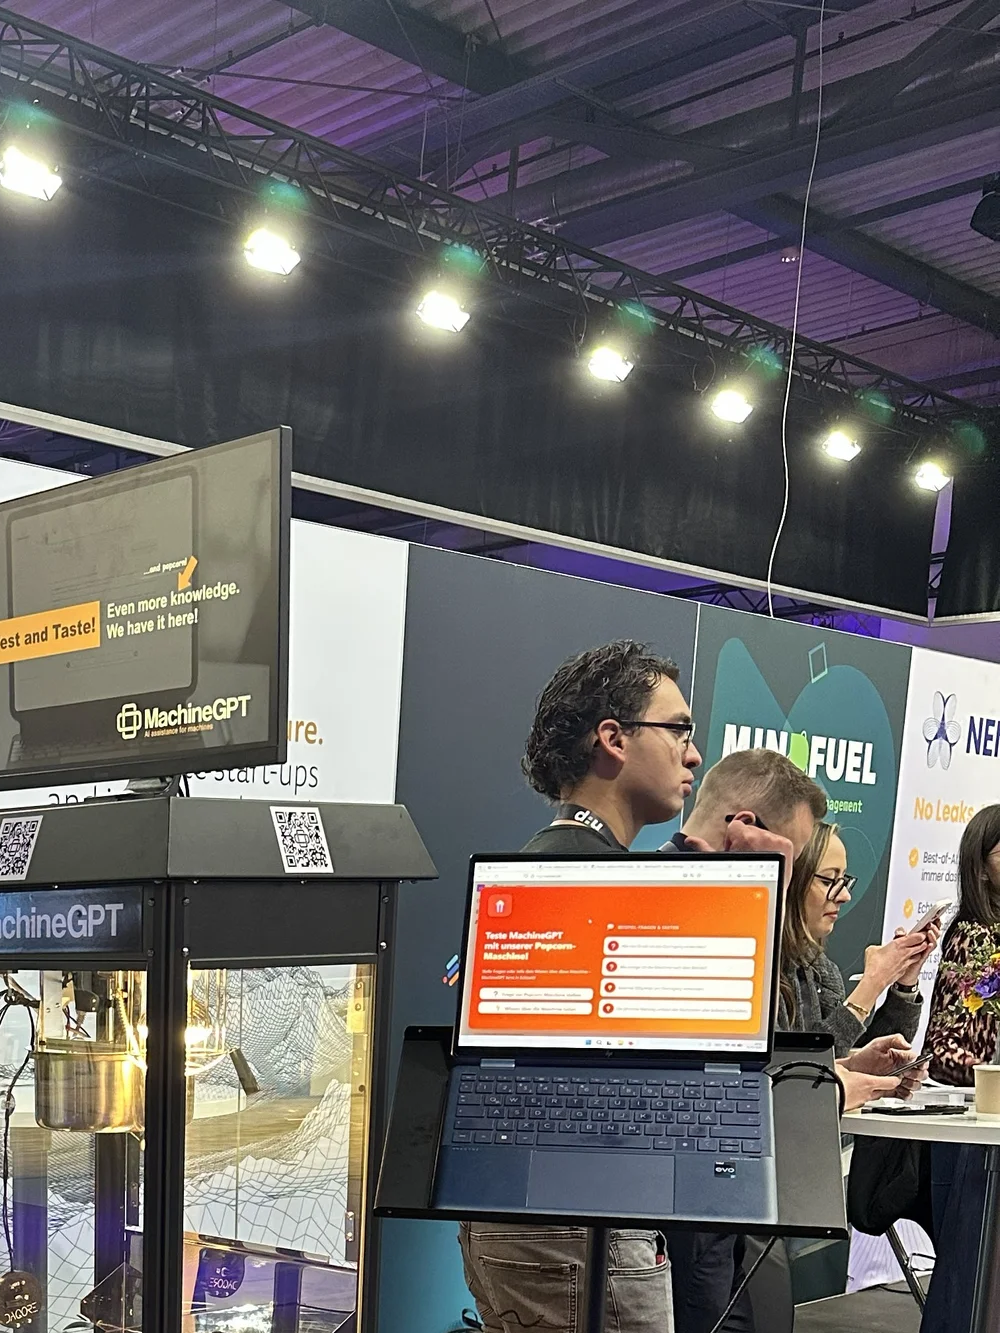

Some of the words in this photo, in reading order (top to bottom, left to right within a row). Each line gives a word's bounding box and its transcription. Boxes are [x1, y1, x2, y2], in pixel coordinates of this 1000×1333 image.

[107, 602, 135, 618] Even
[138, 596, 168, 613] more
[171, 581, 240, 606] knowledge.
[24, 626, 48, 645] and
[53, 617, 96, 640] Taste!
[106, 624, 124, 639] We
[127, 620, 154, 635] have
[157, 614, 166, 630] it
[168, 608, 198, 628] here!
[144, 694, 252, 729] MachineGPT
[151, 727, 178, 738] assistance
[179, 726, 187, 734] for
[188, 723, 214, 733] machines
[914, 797, 933, 820] No
[921, 869, 944, 881] immer
[485, 931, 507, 939] Teste
[509, 931, 563, 940] MachineGPT
[483, 952, 529, 960] Maschine!
[535, 942, 576, 951] Popcorn-
